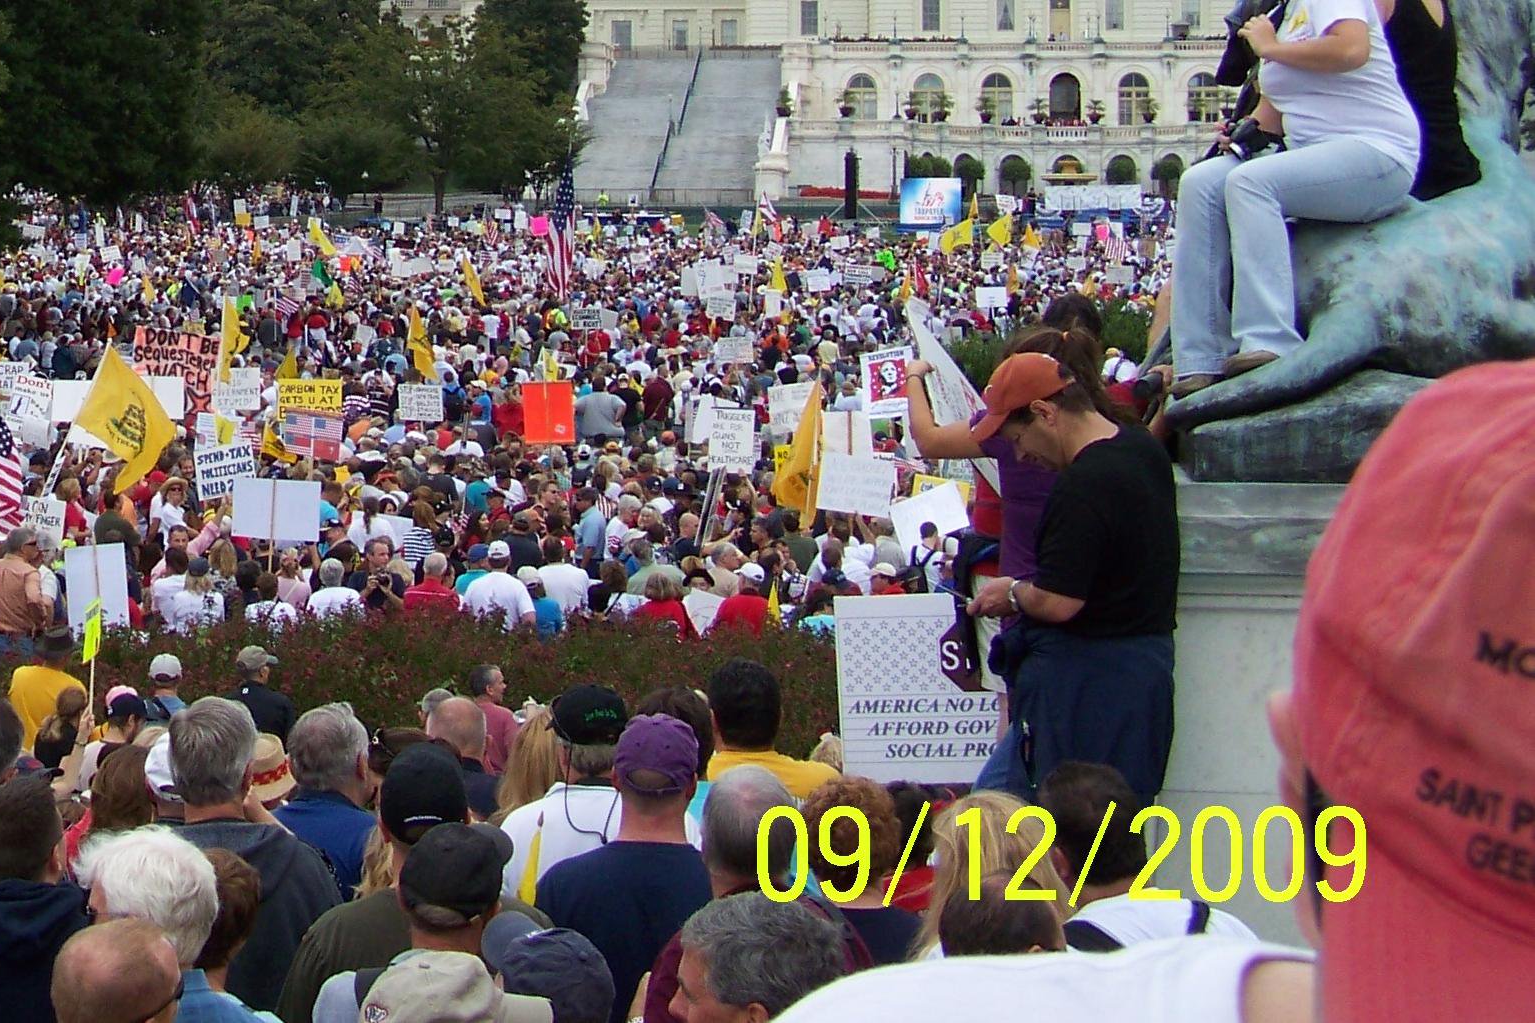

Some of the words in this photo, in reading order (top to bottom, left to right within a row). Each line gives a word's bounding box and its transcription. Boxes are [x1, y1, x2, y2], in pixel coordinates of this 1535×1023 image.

[200, 337, 221, 355] BE
[17, 375, 51, 390] Don't
[279, 384, 316, 394] CARBON
[319, 385, 340, 394] TAX
[280, 395, 304, 404] GETS
[319, 396, 334, 405] AT
[849, 698, 940, 714] AMERICA
[945, 698, 974, 714] NO
[867, 720, 950, 737] AFFORD
[885, 743, 958, 759] SOCIAL
[1418, 767, 1504, 826] SAINT
[1511, 799, 1535, 839] P
